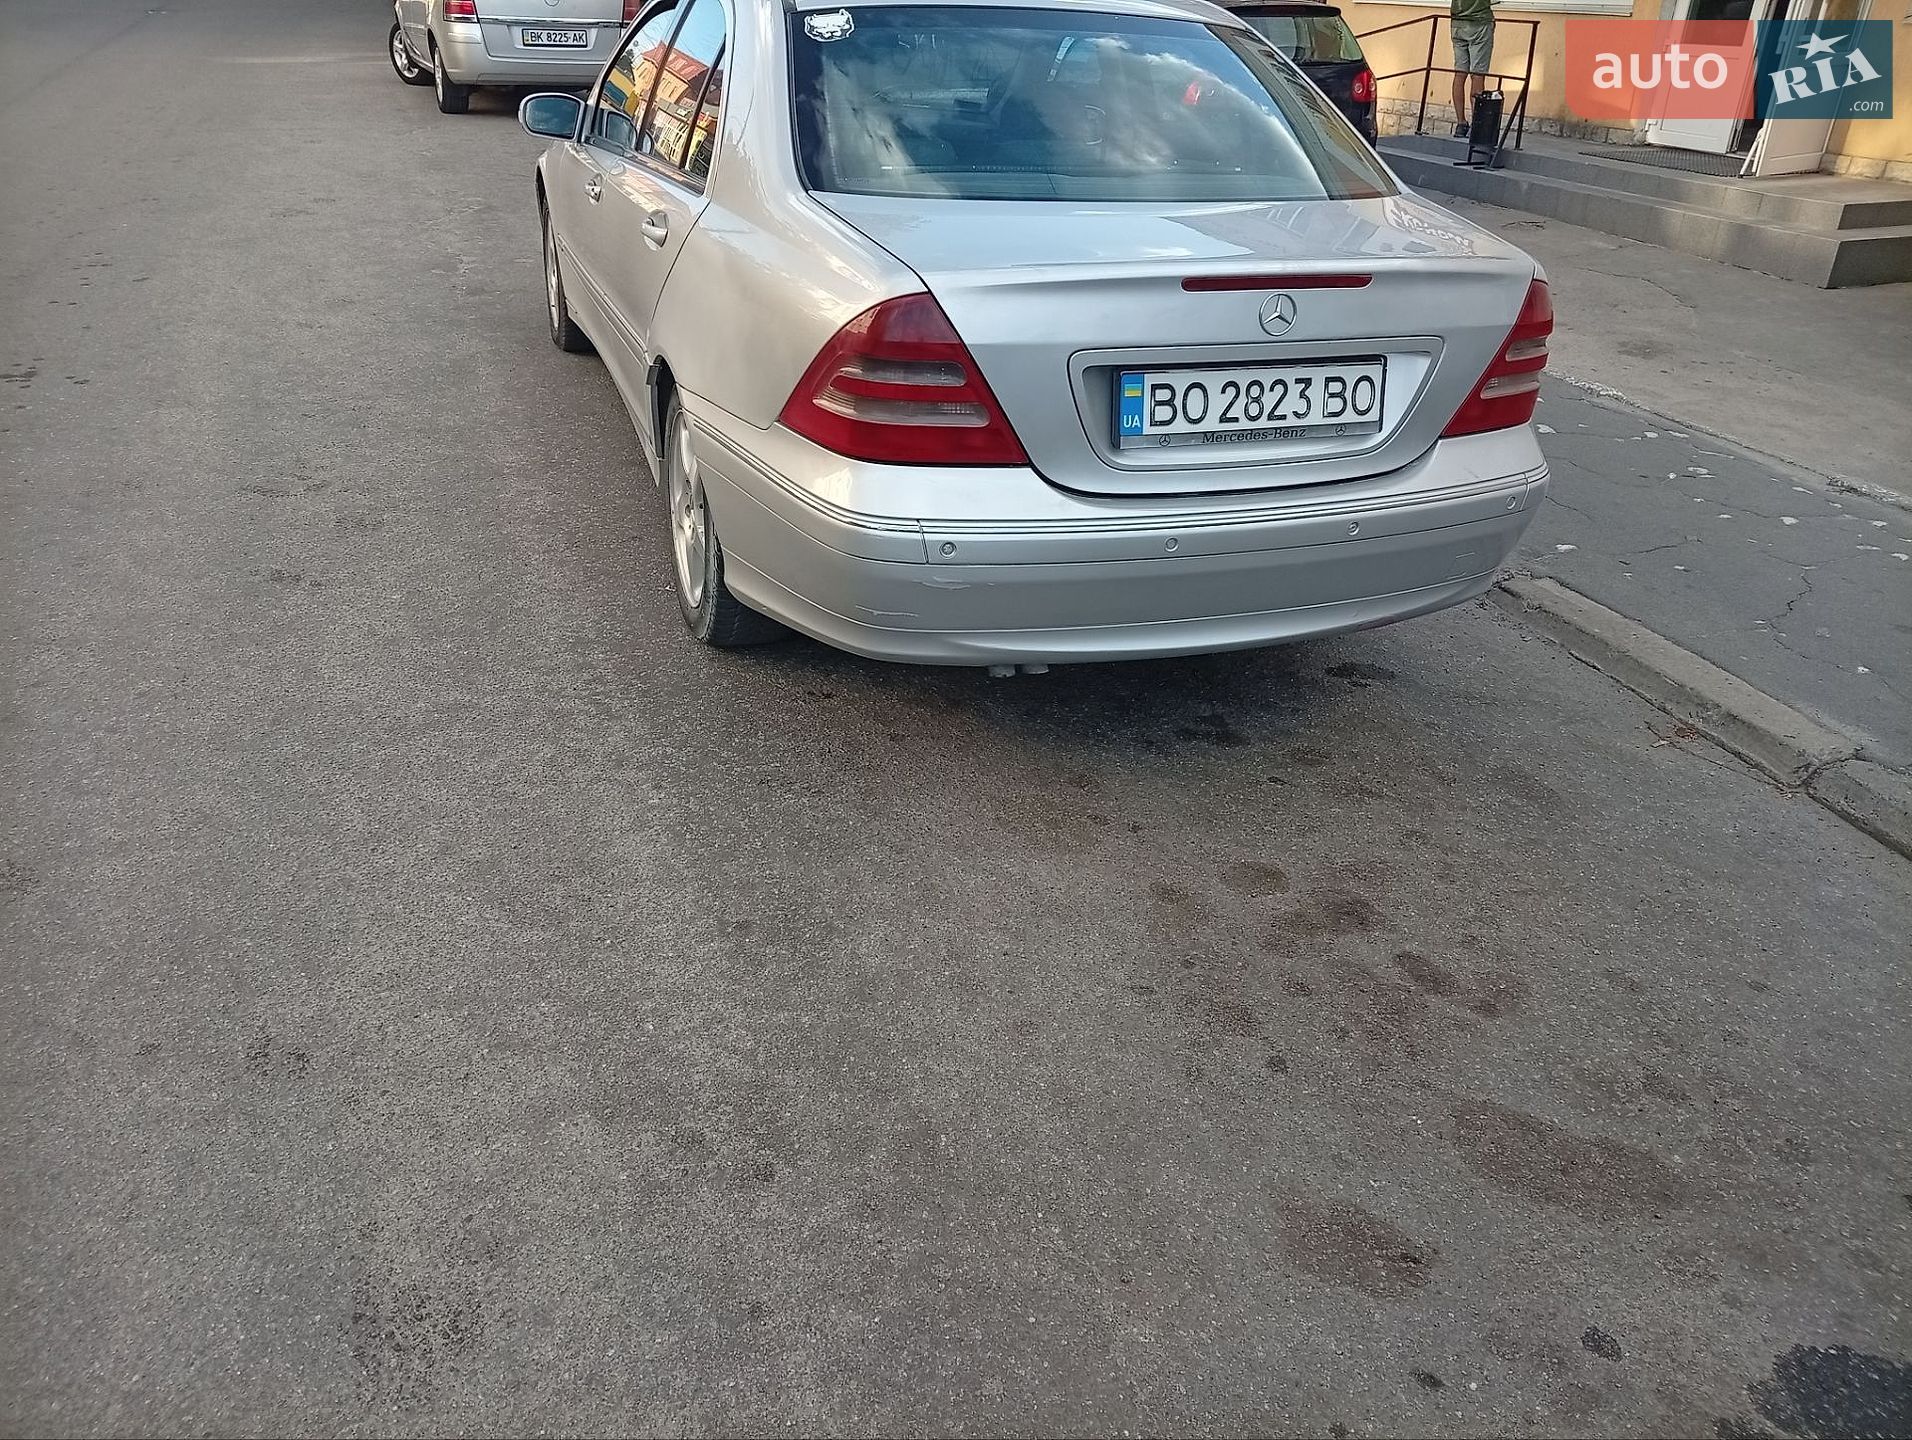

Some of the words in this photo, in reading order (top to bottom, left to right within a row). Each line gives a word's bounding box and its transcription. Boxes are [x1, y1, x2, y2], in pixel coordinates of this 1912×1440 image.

[530, 31, 543, 42] BK
[546, 32, 569, 42] 8225
[572, 32, 585, 43] AK
[1149, 382, 1209, 427] BO
[1218, 377, 1313, 424] 2823
[1322, 374, 1376, 418] BO
[1123, 414, 1141, 428] UA
[1202, 426, 1306, 444] Mercedes-Benz
